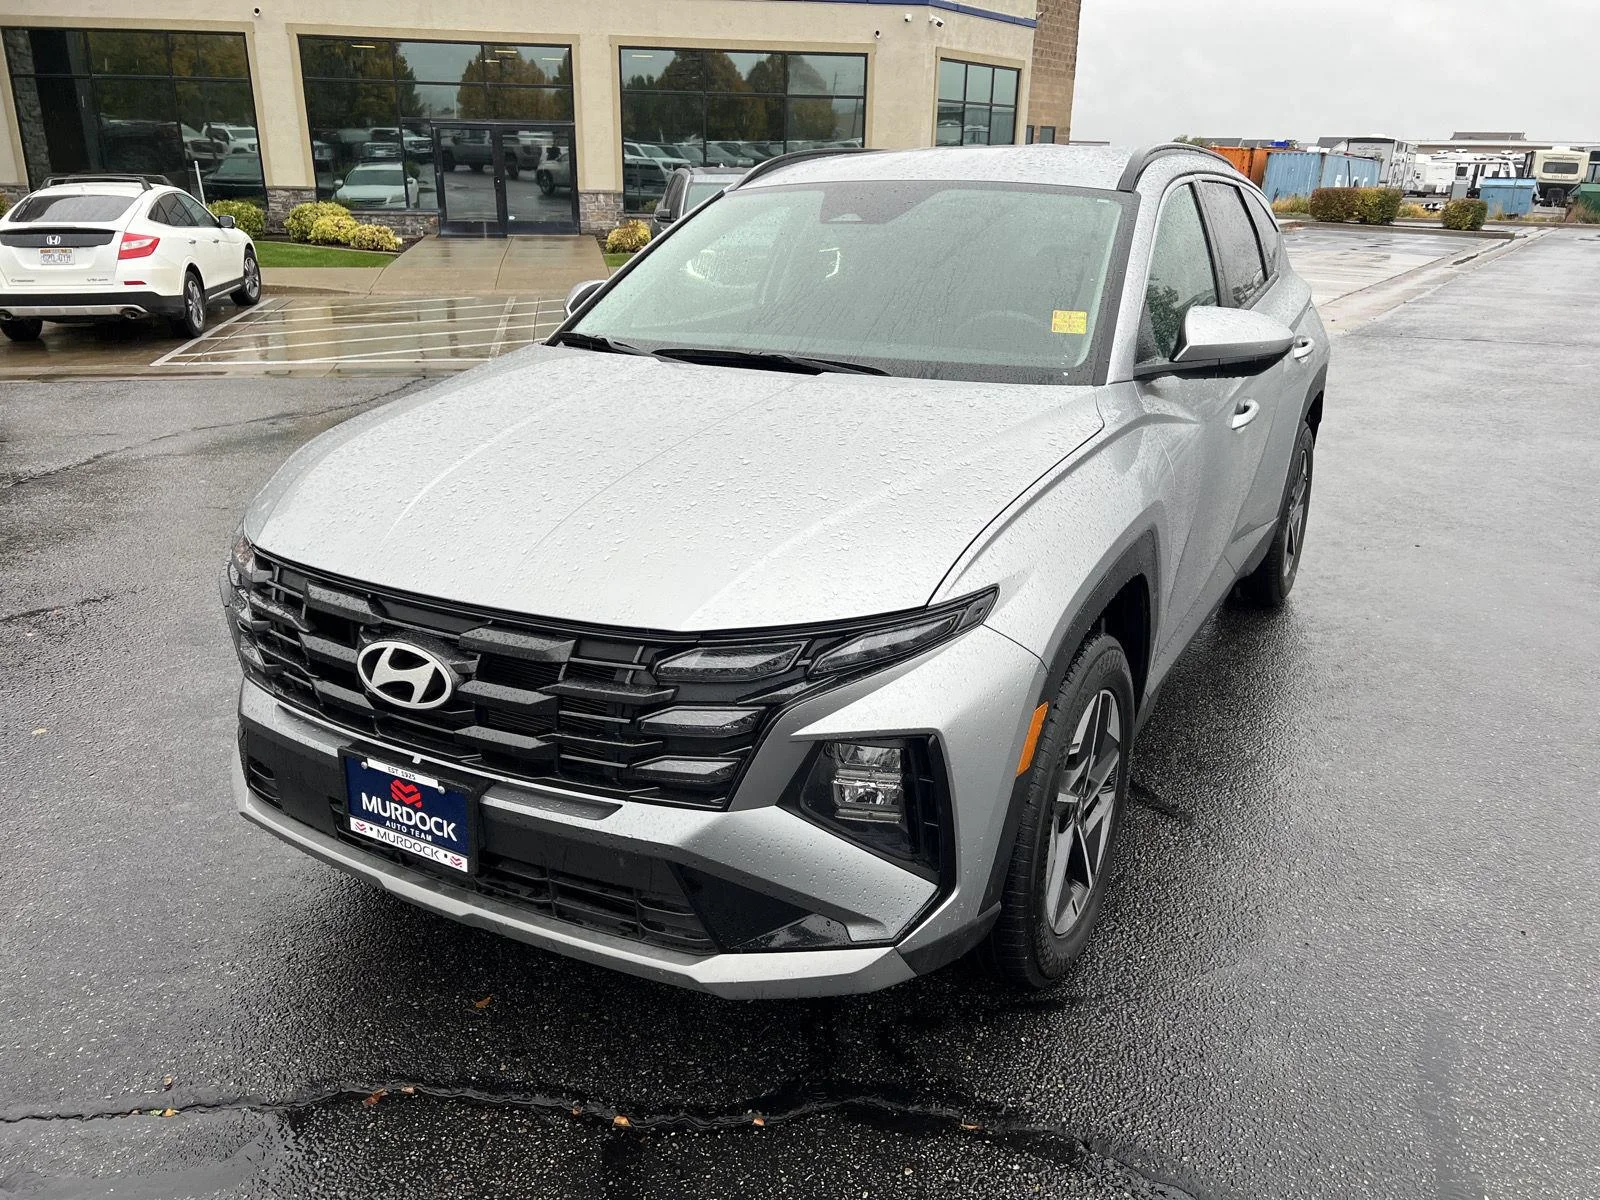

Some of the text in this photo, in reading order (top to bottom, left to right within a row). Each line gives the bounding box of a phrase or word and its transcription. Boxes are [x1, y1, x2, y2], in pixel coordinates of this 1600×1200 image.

[361, 792, 458, 842] MURDOCK
[386, 820, 432, 842] AUTO TEAM
[377, 829, 440, 860] MURDOCK
